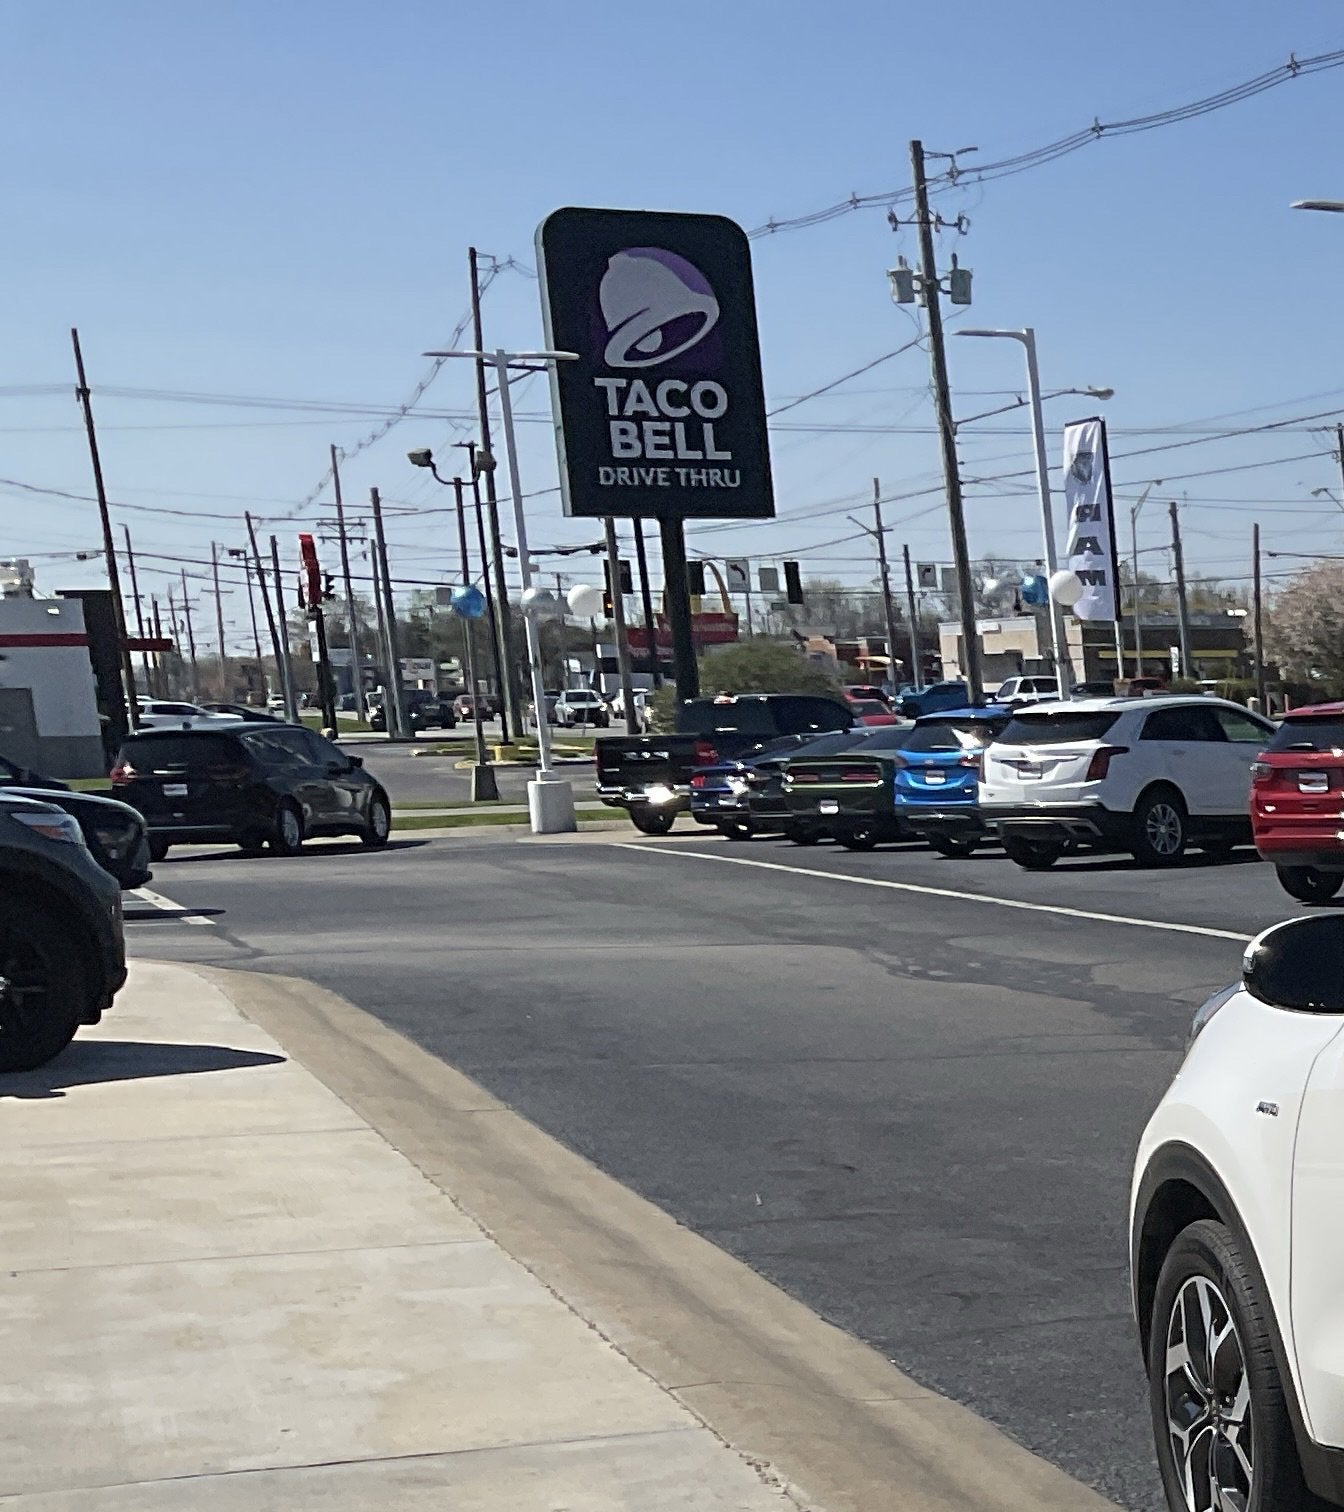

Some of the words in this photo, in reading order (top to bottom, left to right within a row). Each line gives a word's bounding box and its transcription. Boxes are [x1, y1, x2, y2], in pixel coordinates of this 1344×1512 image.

[593, 377, 728, 419] TACO
[609, 420, 732, 460] BELL
[598, 466, 671, 486] DRIVE
[674, 467, 741, 488] THRU
